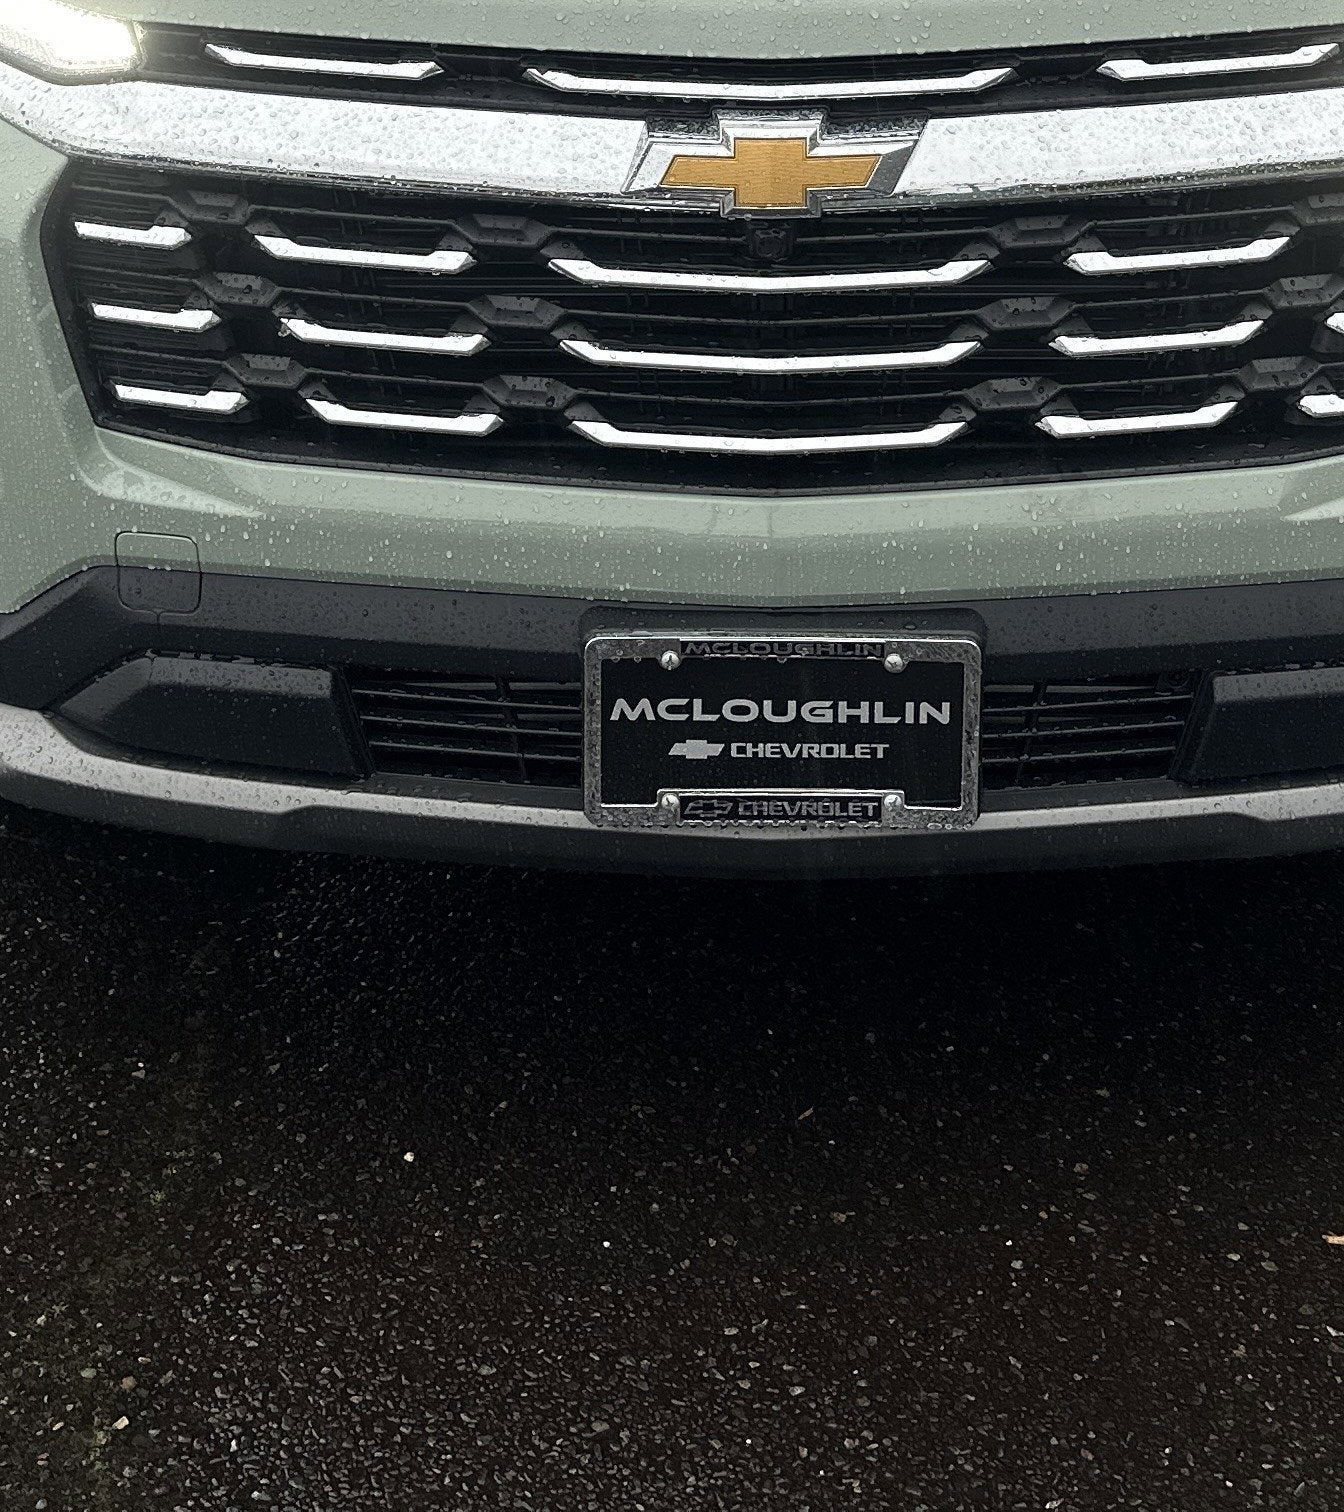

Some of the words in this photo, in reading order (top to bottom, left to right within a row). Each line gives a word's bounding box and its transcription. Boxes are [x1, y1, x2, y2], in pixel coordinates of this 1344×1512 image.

[684, 642, 883, 657] MCLOUGHLIN
[609, 697, 951, 725] MCLOUGHLIN
[730, 741, 890, 760] CHEVROLET
[737, 800, 879, 818] CHEVROLET
